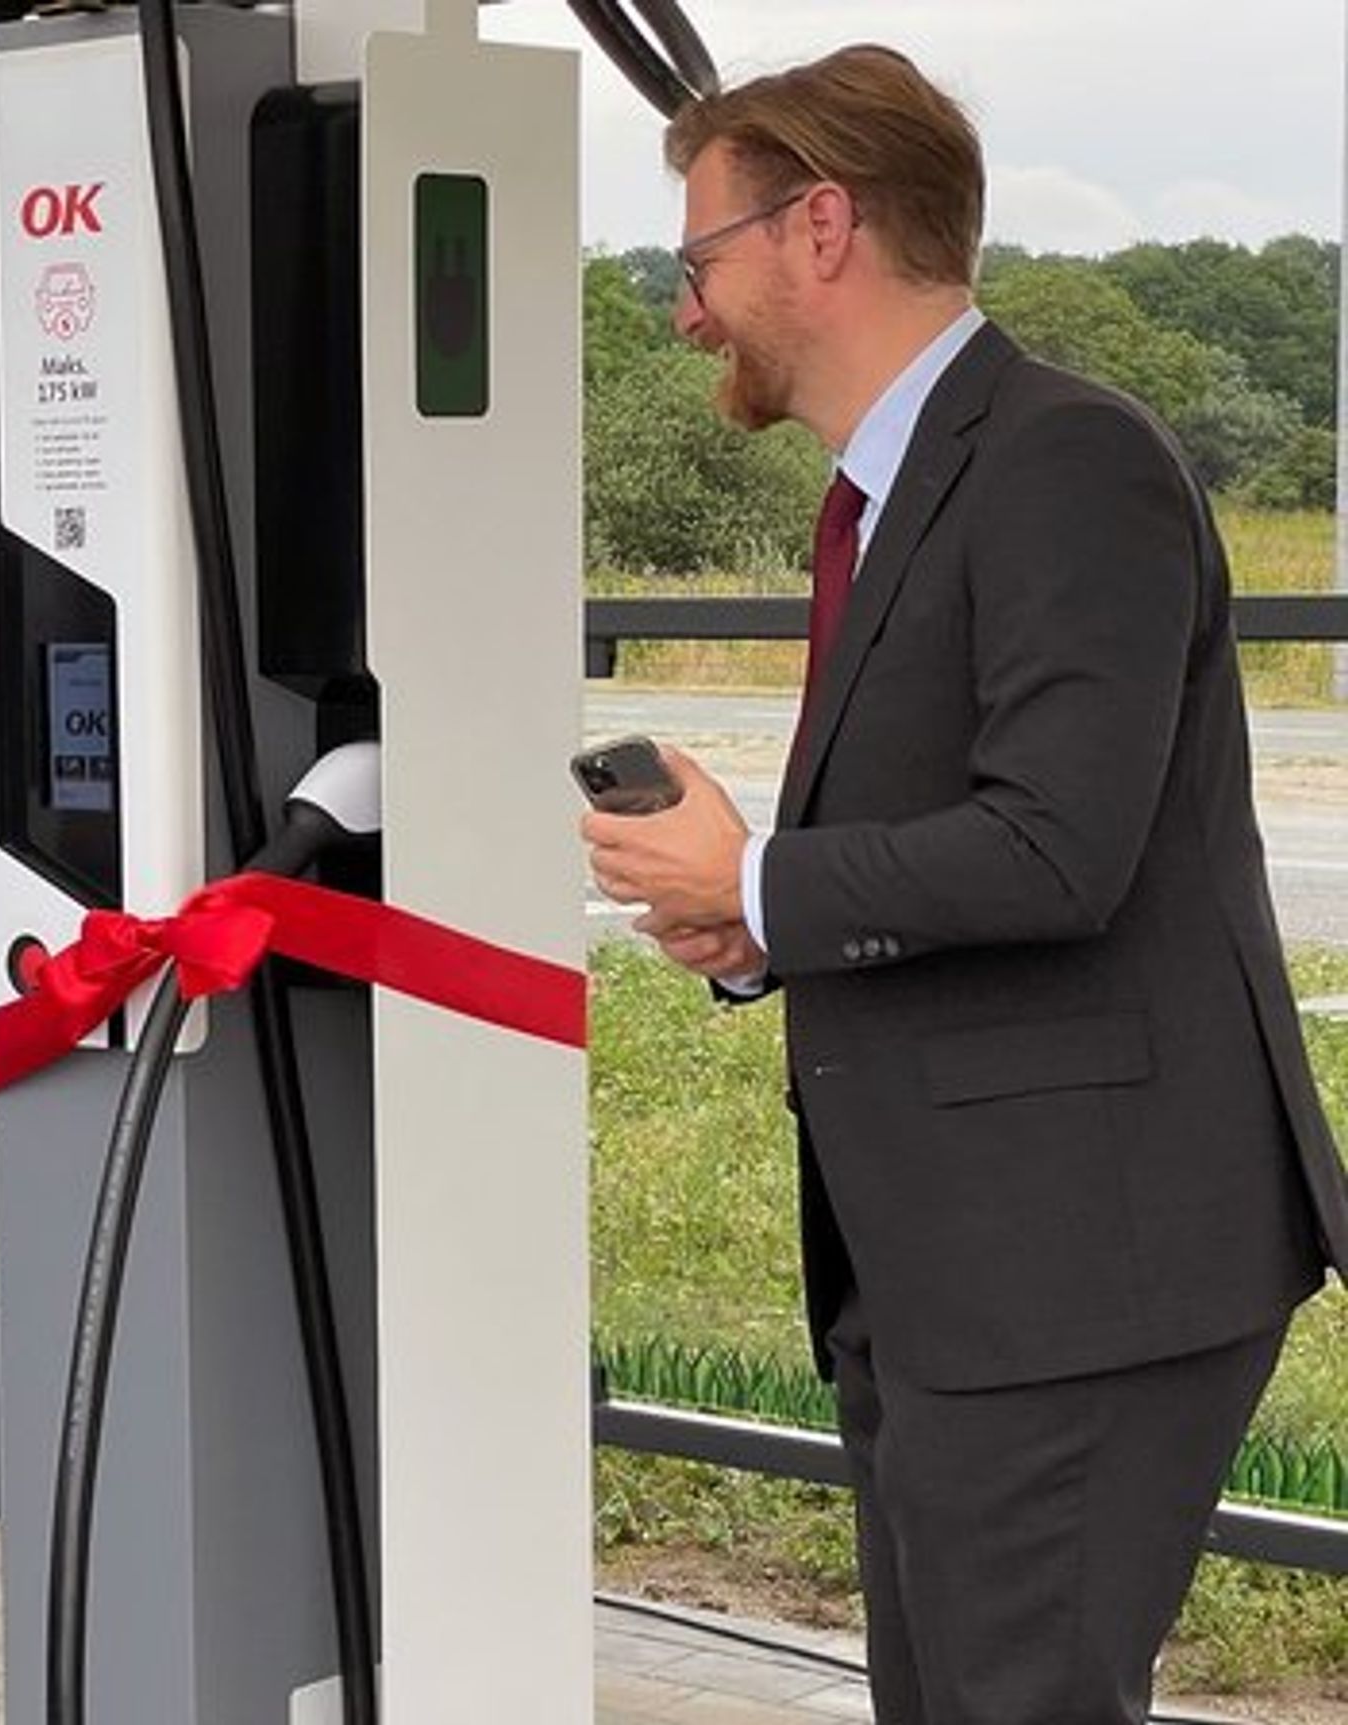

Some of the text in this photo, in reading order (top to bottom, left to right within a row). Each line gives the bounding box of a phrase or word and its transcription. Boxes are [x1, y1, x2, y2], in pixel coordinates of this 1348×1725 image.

[22, 182, 104, 238] OK
[38, 381, 66, 402] 175
[65, 708, 106, 737] OK
